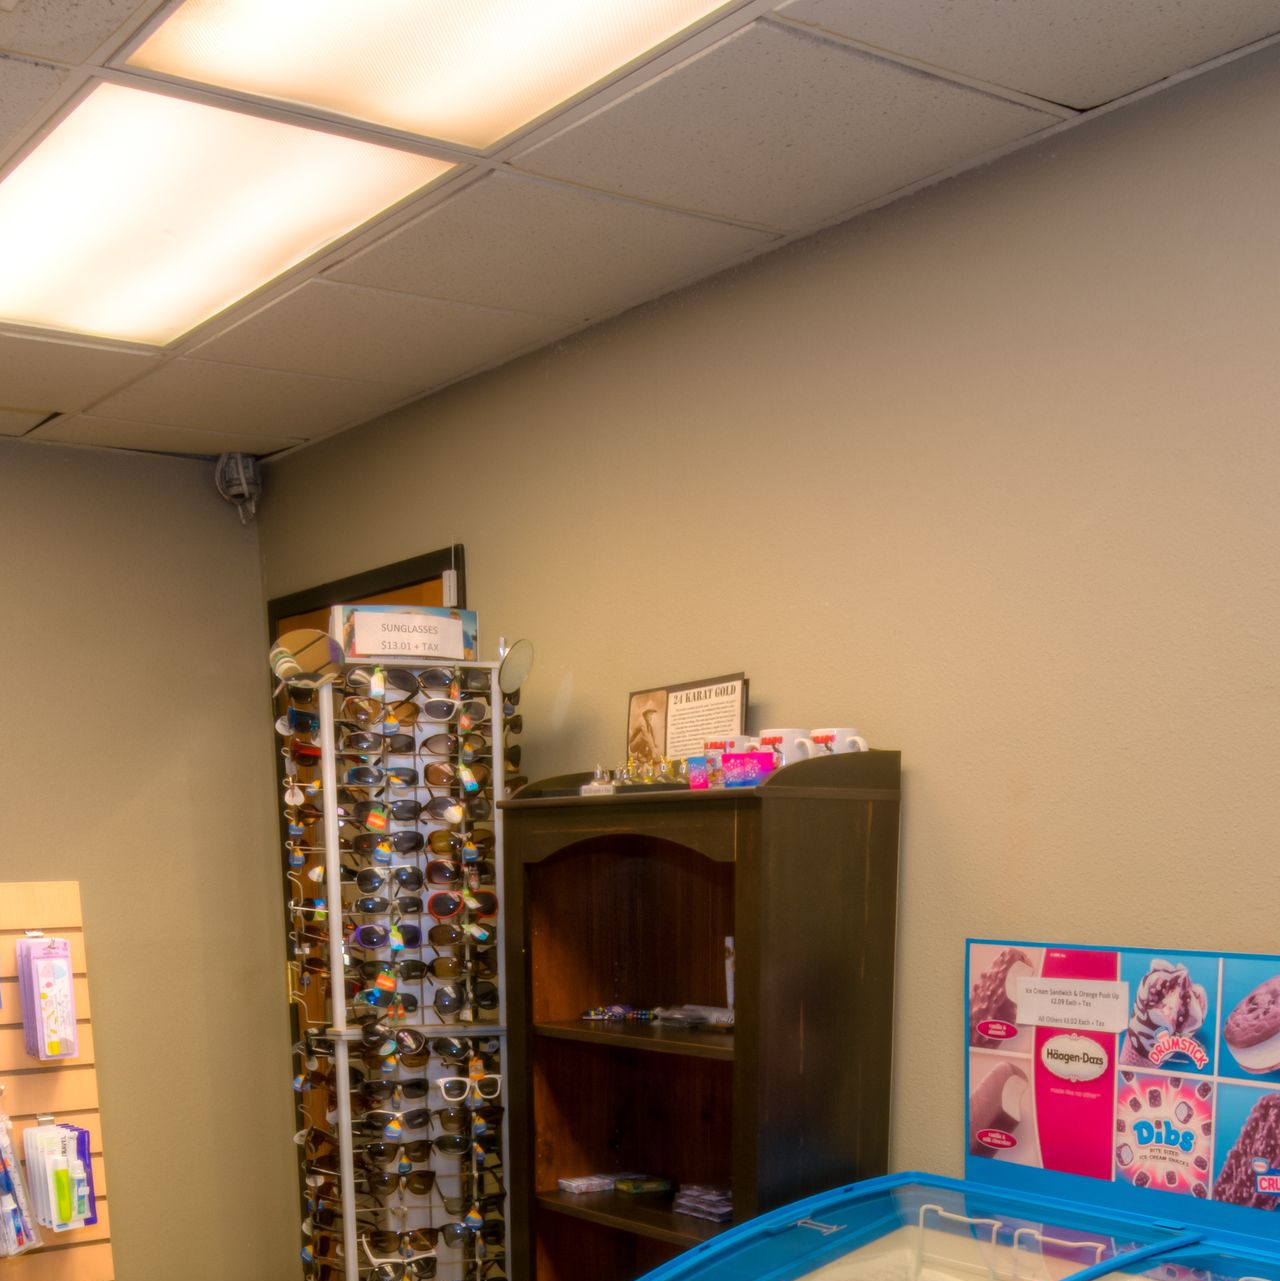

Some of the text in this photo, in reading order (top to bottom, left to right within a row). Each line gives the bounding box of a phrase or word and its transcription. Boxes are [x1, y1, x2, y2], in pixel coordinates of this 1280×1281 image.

[381, 624, 438, 634] SUNGLASSES
[381, 641, 411, 650] $13.01
[422, 642, 438, 651] TAX
[673, 684, 737, 705] 24 KARAT GOLD
[1050, 988, 1072, 997] Sandwich
[1079, 990, 1098, 999] Orange
[1099, 991, 1111, 999] Push
[1045, 1016, 1063, 1024] Others
[1046, 1048, 1104, 1065] Häagen-Dazs
[1148, 1036, 1209, 1070] DRUMSTICK
[1133, 1120, 1195, 1152] Dibs
[1149, 1155, 1167, 1163] CREAM
